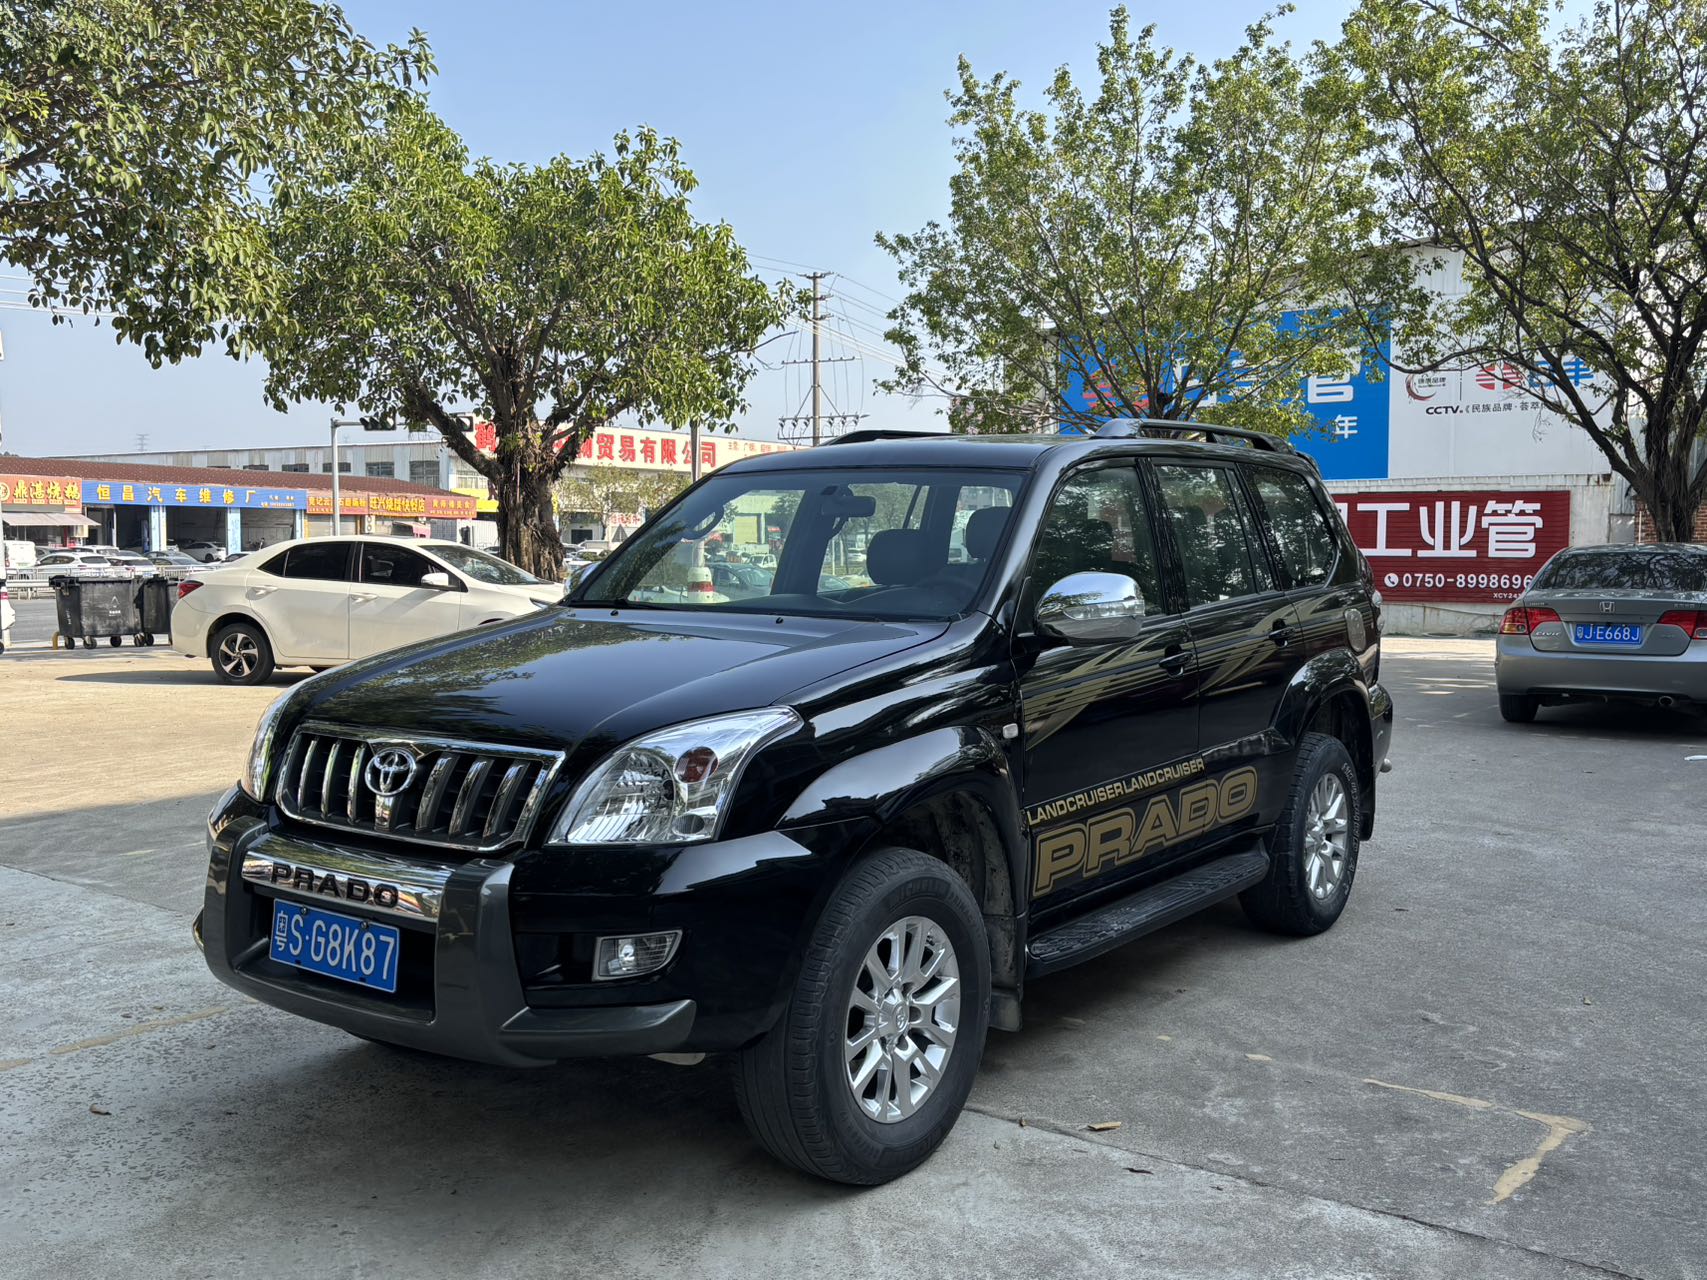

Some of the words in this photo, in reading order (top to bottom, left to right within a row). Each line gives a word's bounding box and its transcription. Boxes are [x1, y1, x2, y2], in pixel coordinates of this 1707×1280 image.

[97, 484, 256, 504] 恒昌汽车维修厂
[1336, 500, 1543, 558] 工业管
[1403, 573, 1533, 589] 0750-8998696
[1033, 765, 1258, 898] PRADO
[271, 862, 399, 908] PRADO
[275, 909, 396, 980] 粤S·G8K87
